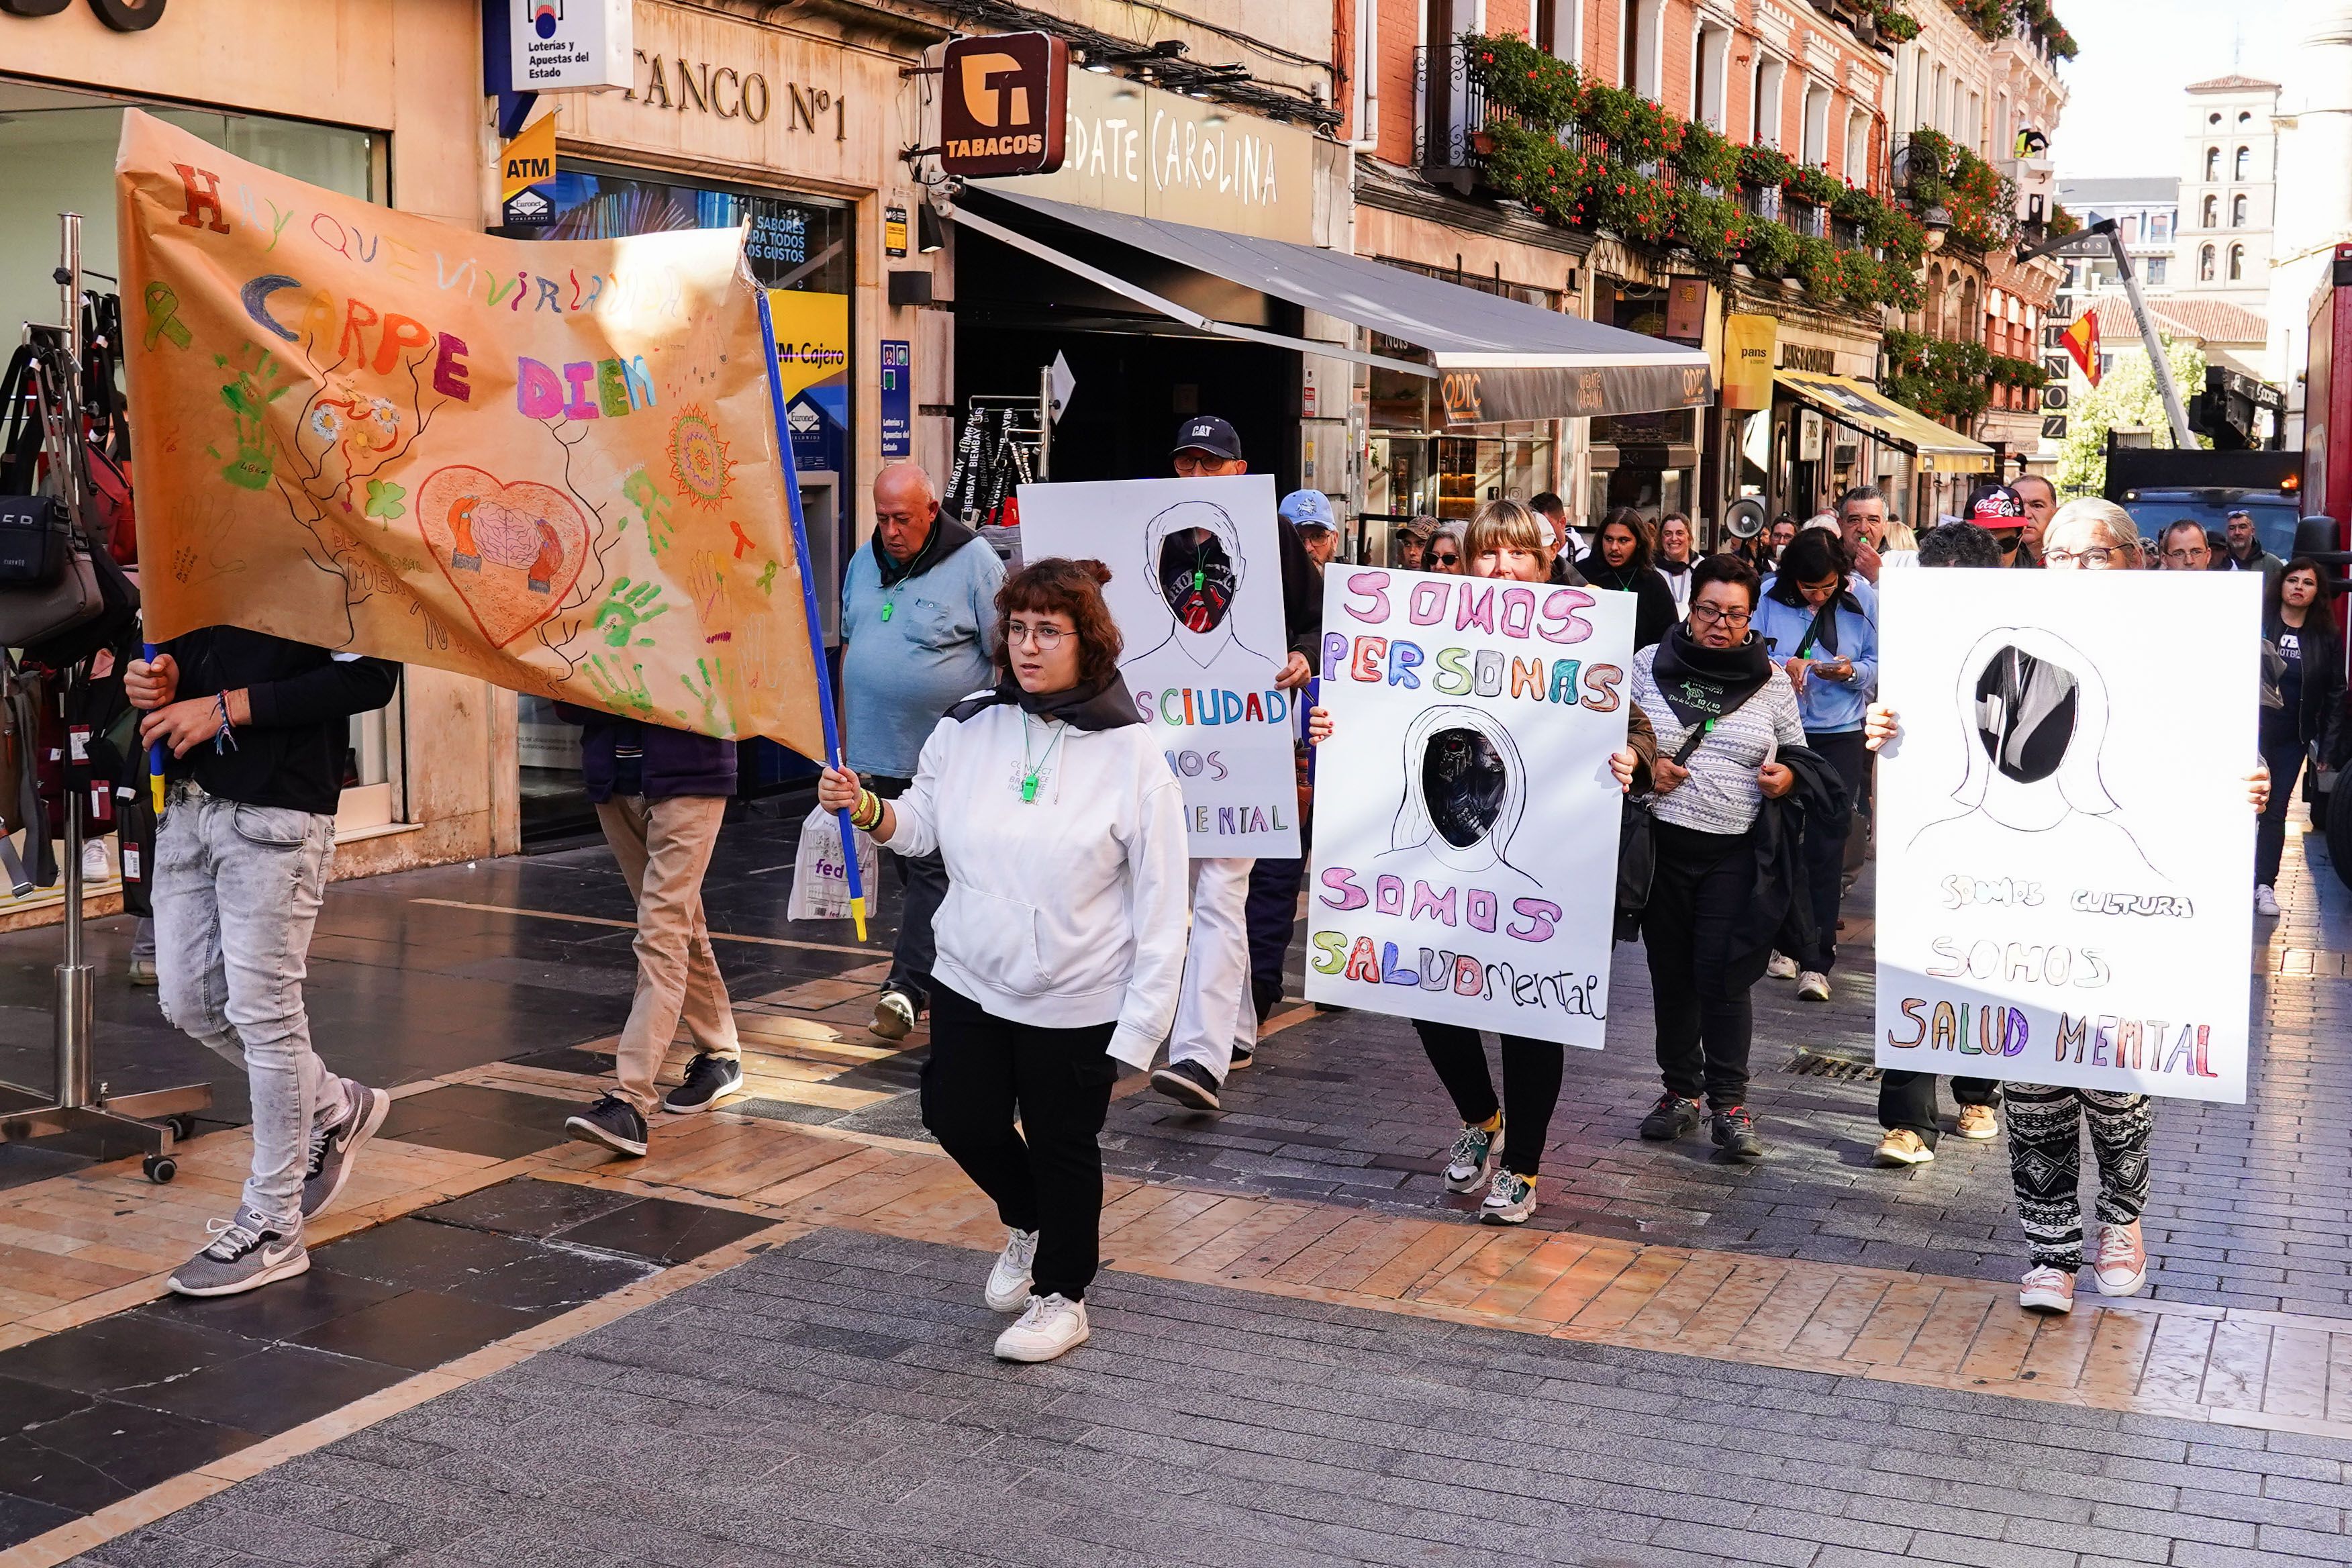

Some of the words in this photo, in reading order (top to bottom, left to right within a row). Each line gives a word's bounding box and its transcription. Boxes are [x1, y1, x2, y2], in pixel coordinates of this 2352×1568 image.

[528, 41, 566, 52] Loterías
[569, 41, 575, 52] y
[528, 54, 572, 66] Apuestas
[575, 52, 589, 62] del
[528, 69, 560, 79] Estado
[946, 134, 1042, 158] TABACOS
[1152, 109, 1277, 206] CAROLINA
[507, 158, 550, 179] ATM
[516, 200, 542, 208] Euronet
[170, 161, 294, 252] HAY
[311, 212, 419, 283] QUE
[756, 215, 805, 235] SABORES
[746, 244, 762, 257] OS
[763, 246, 805, 263] GUSTOS
[769, 231, 805, 248] TODOS
[240, 274, 471, 403] CARPE
[516, 354, 658, 422] DIEM
[801, 342, 844, 369] Cajero
[1741, 347, 1767, 359] pans
[1442, 373, 1481, 411] QDTC
[1191, 426, 1211, 437] CAT
[944, 458, 966, 499] BIEMBAY
[963, 473, 977, 513] BIEMBAY
[1343, 571, 1596, 644] SOMOS
[1323, 632, 1624, 713] PERSONAS
[1318, 867, 1563, 942] SOMOS
[2070, 888, 2194, 919] CULTURA
[1312, 930, 1483, 997] SALUD
[1482, 961, 1606, 1021] Mental
[1925, 936, 2112, 989] SOMOS
[1888, 997, 2029, 1058] SALUD
